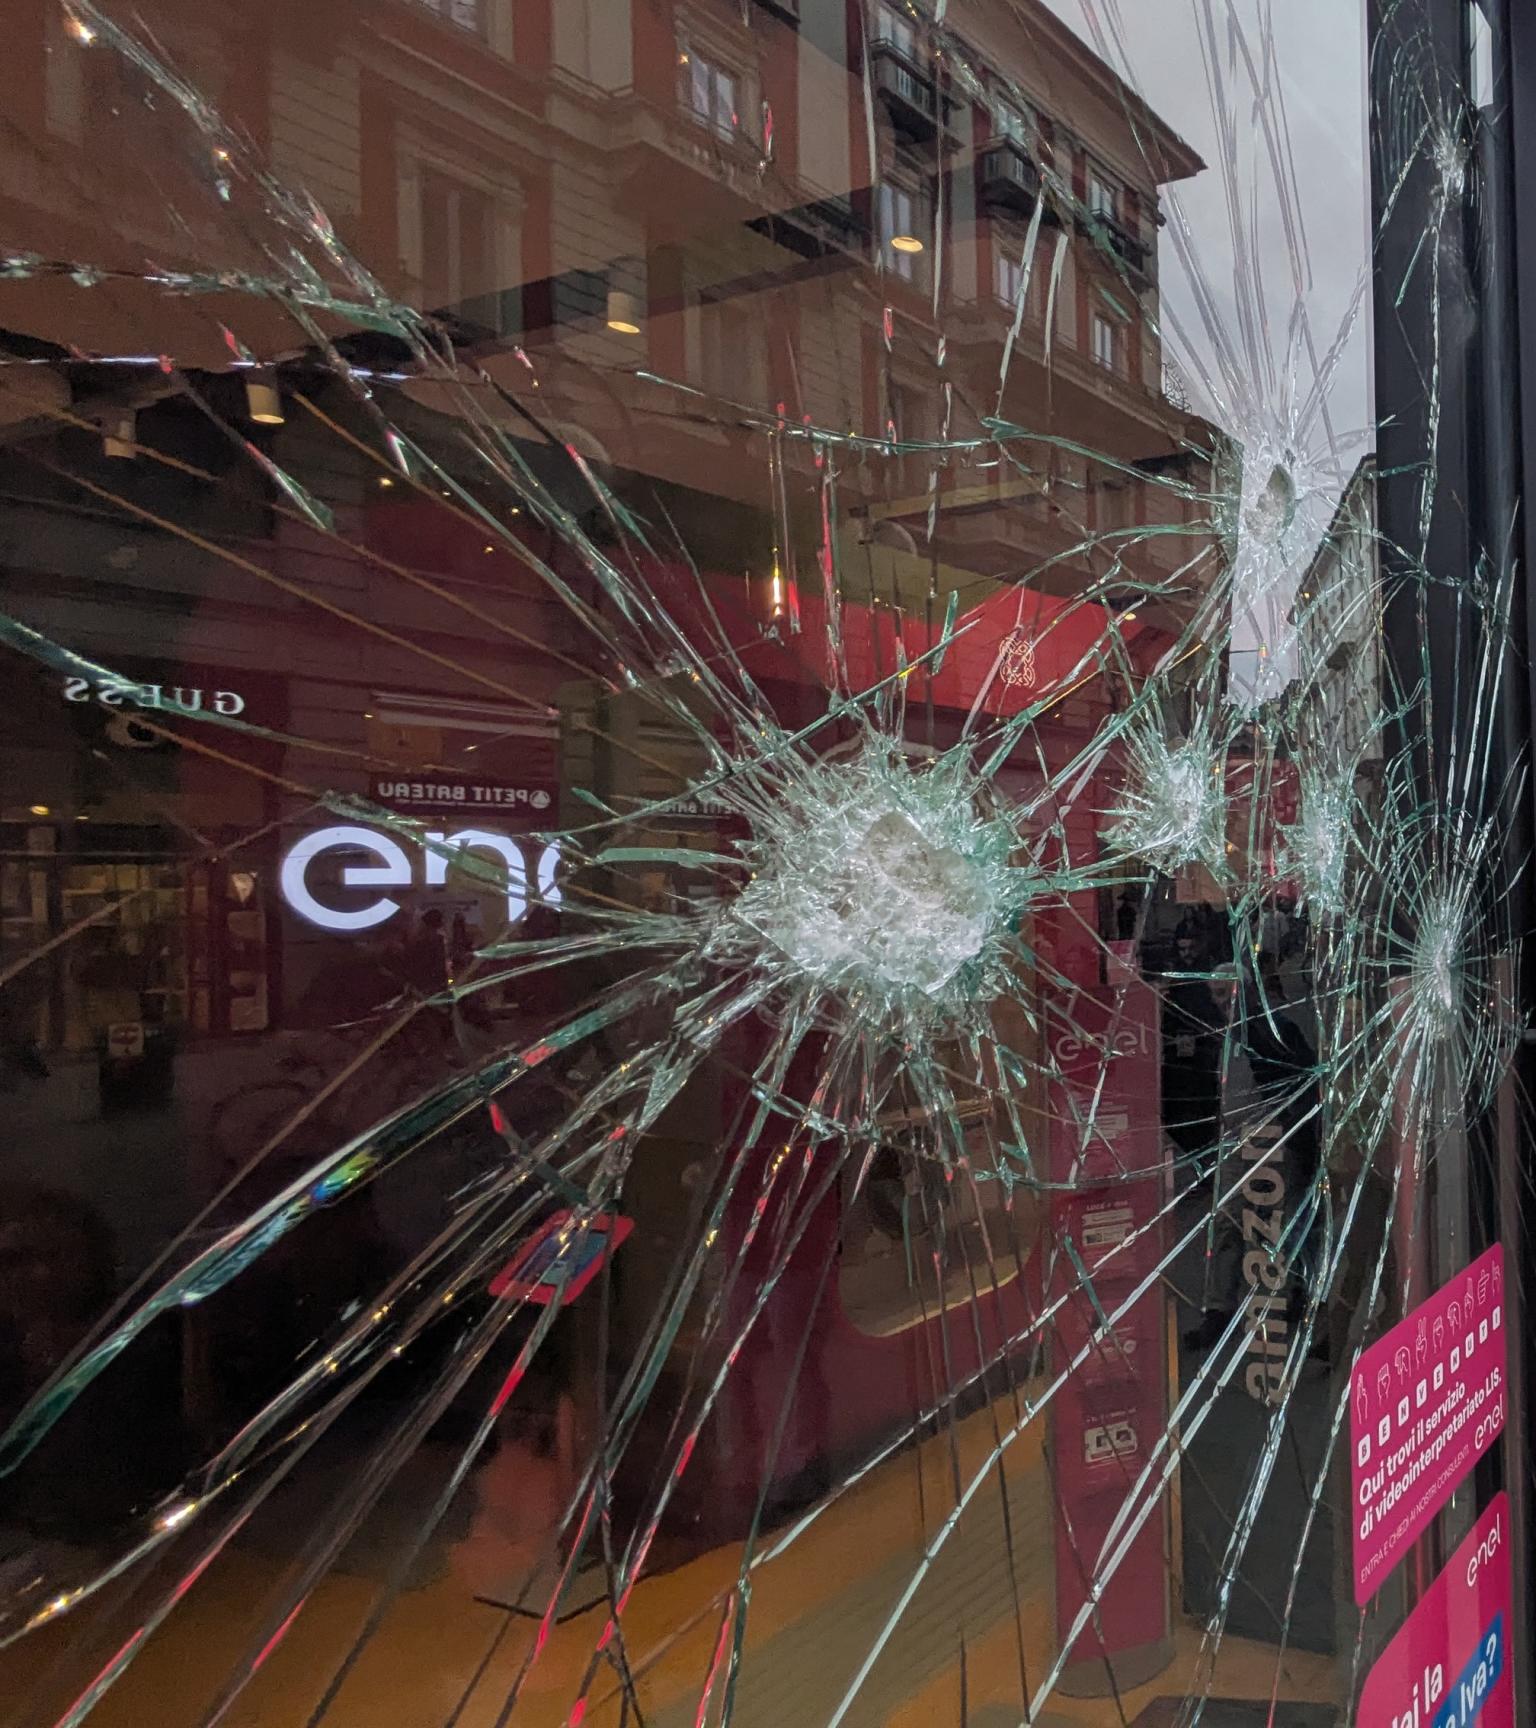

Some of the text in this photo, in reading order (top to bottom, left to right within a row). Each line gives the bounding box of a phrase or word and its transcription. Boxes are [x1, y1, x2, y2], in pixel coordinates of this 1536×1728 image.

[1242, 1124, 1288, 1406] amazon
[1359, 1381, 1465, 1505] Qui trovi il servizio
[1474, 1394, 1504, 1450] enel
[1360, 1506, 1373, 1540] di
[1375, 1388, 1485, 1522] videointerpretariato
[1361, 1547, 1384, 1583] ENTRA
[1467, 1513, 1501, 1587] enel
[1424, 1664, 1443, 1714] la
[1460, 1633, 1497, 1726] Iva?
